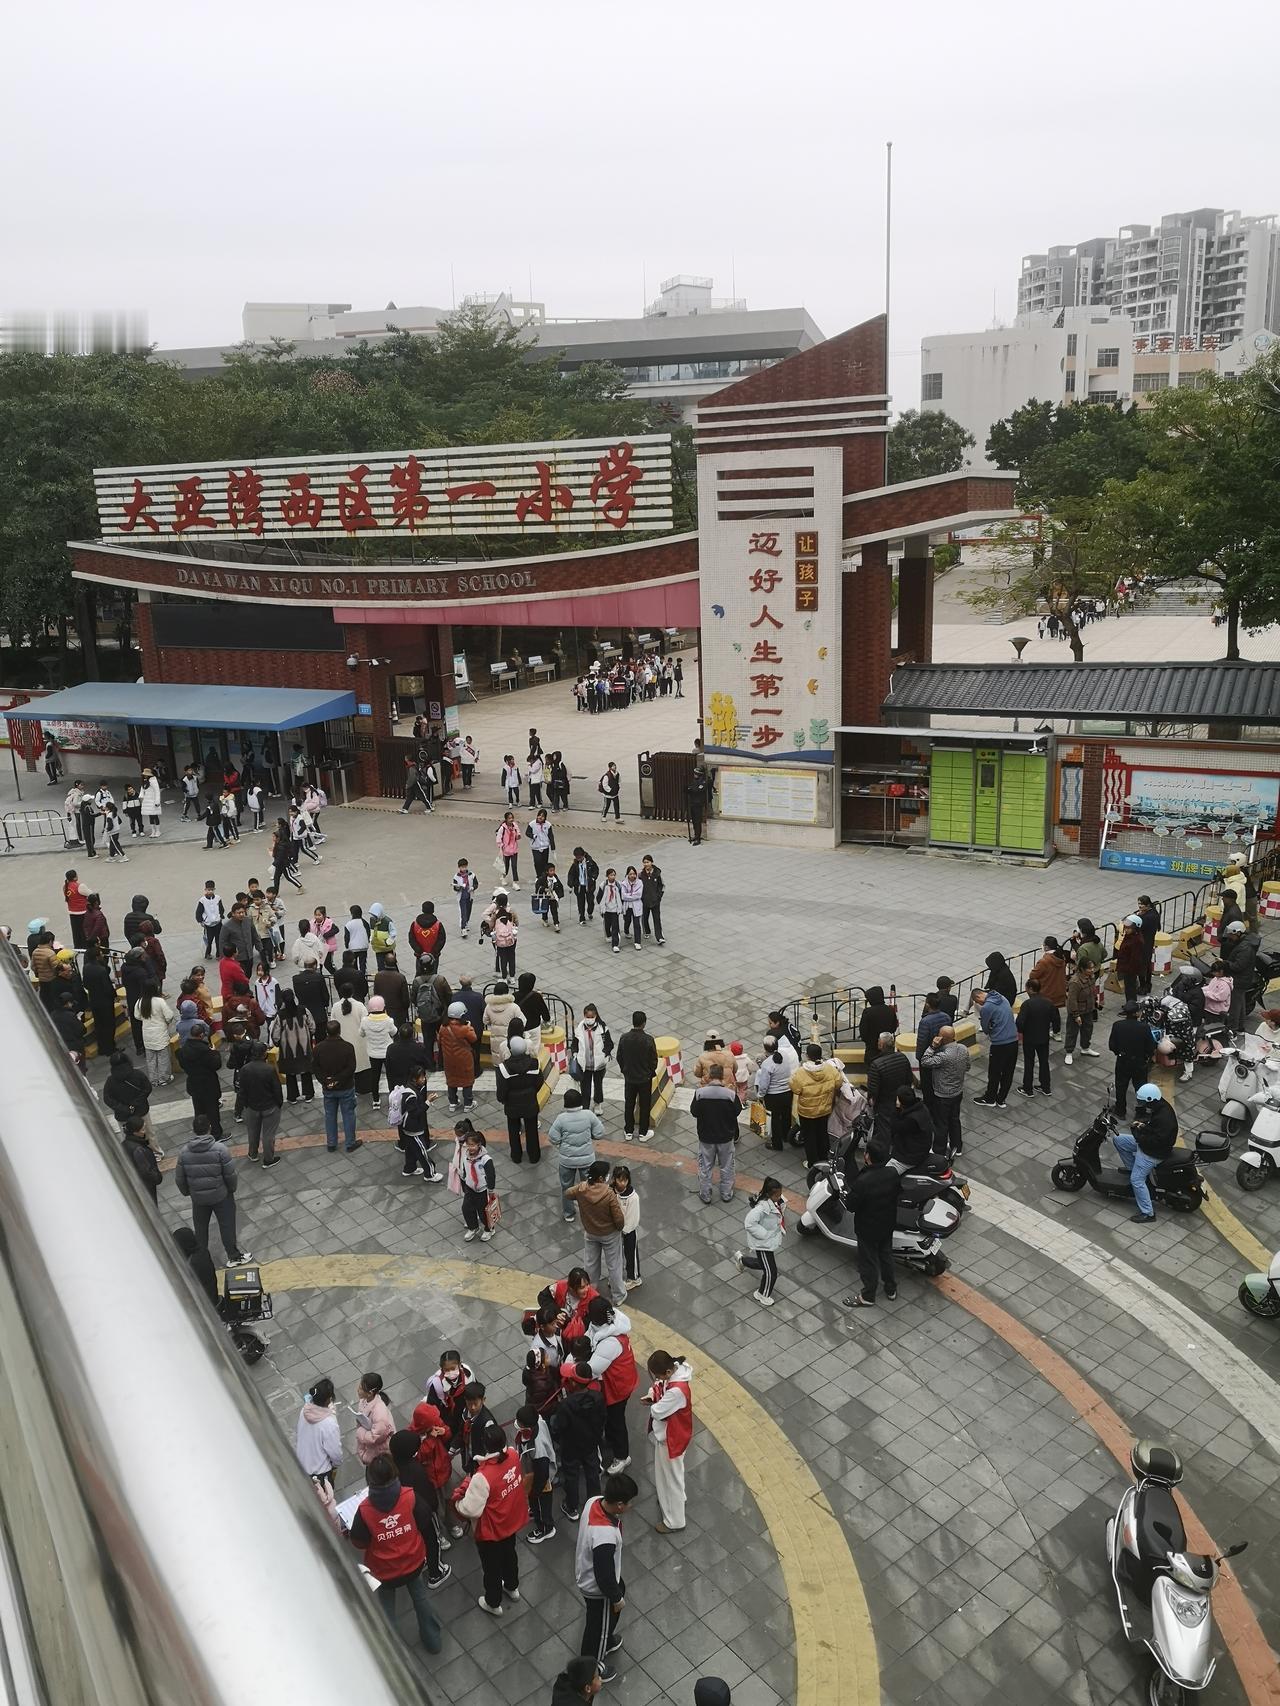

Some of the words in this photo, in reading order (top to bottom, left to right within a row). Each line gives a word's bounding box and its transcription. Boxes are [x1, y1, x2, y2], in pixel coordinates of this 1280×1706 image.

[120, 442, 644, 536] 大亚湾西区第一小学
[320, 578, 360, 594] NO.1
[367, 577, 449, 594] PRIMARY
[457, 571, 537, 593] SCHOOL
[799, 535, 815, 607] 让孩子
[748, 532, 784, 750] 迈好人生第一步
